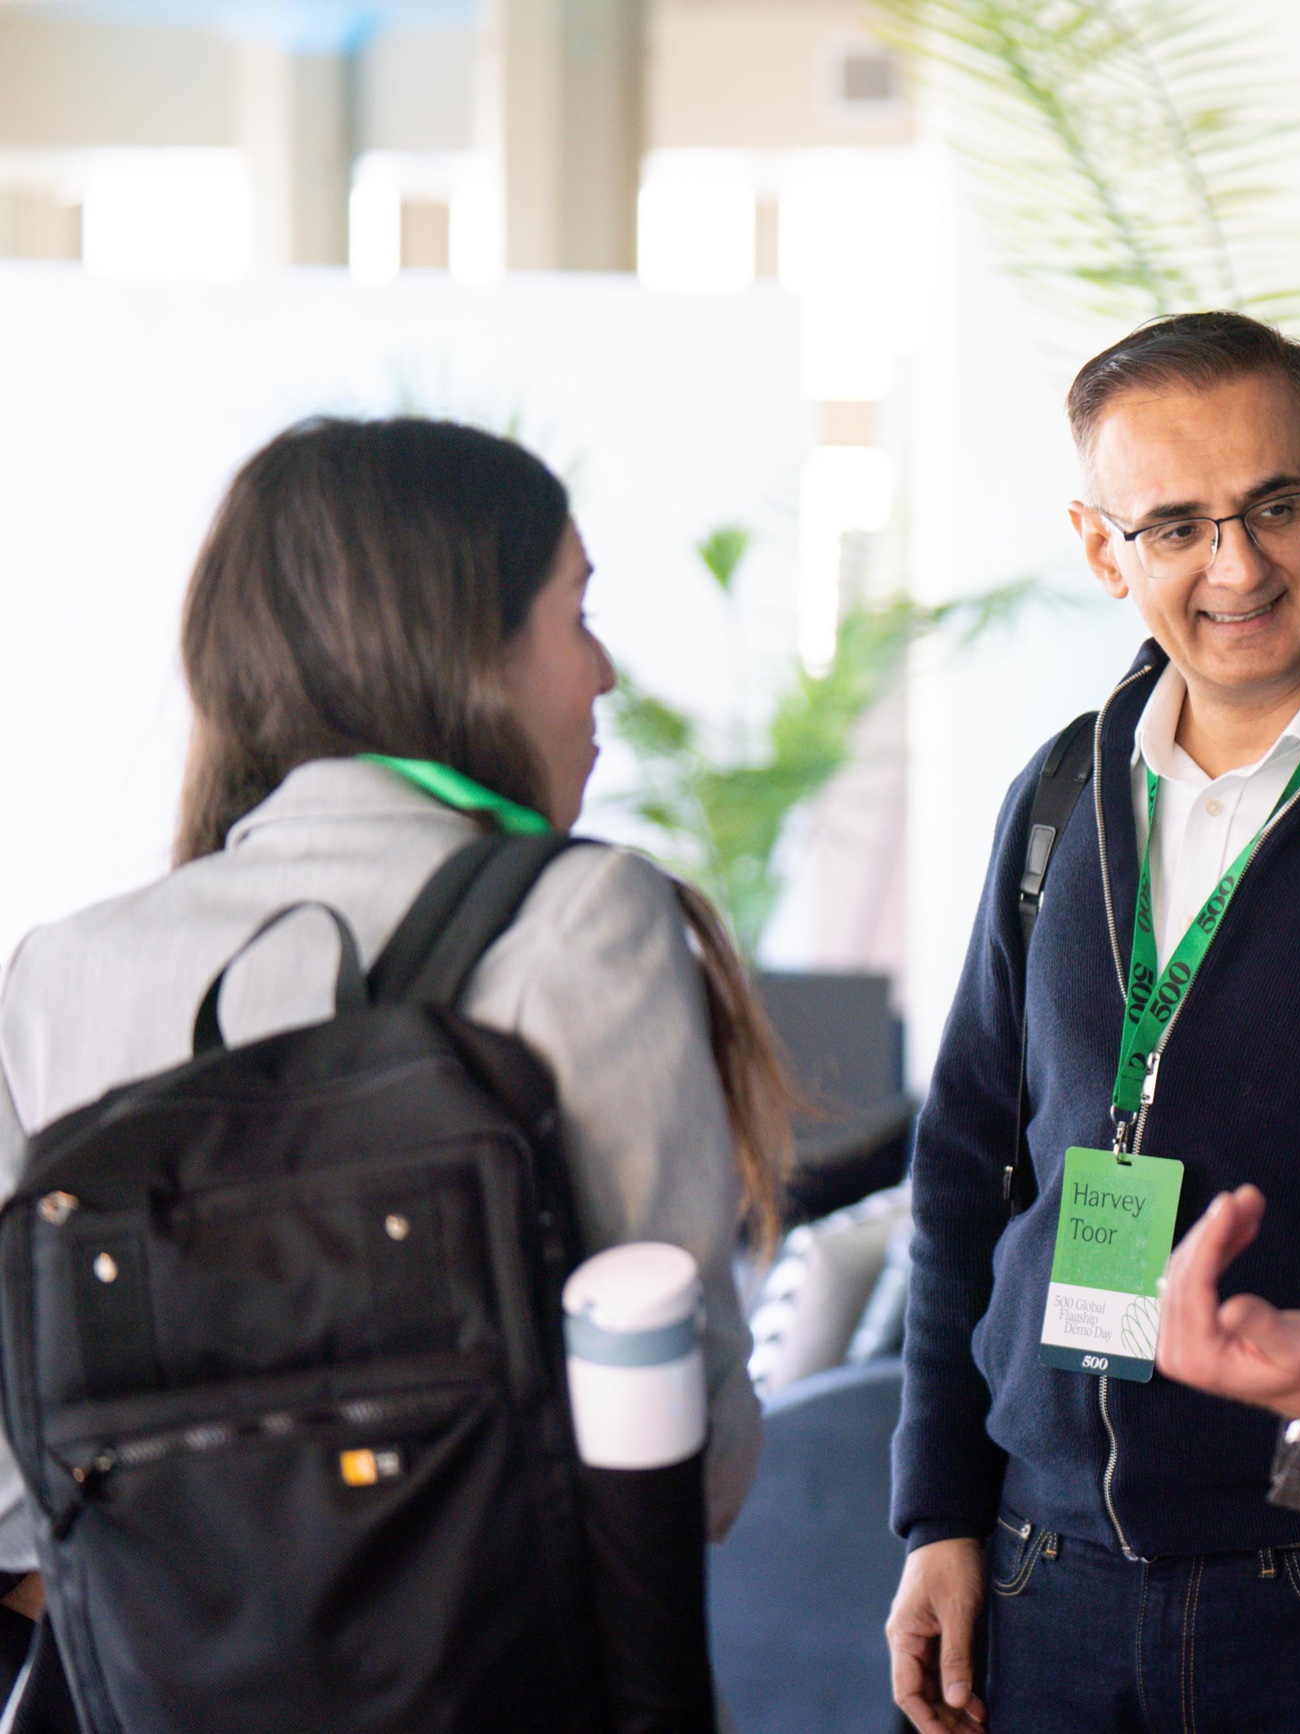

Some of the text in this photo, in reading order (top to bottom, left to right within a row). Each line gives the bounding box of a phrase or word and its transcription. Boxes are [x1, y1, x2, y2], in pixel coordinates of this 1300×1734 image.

[1197, 875, 1234, 934] 500
[1149, 961, 1191, 1023] 500
[1074, 1182, 1146, 1217] Harvey
[1071, 1218, 1117, 1244] Toor
[1054, 1296, 1106, 1314] 500 Global
[1059, 1311, 1098, 1326] Flagship
[1064, 1322, 1113, 1342] Demo Day
[1082, 1355, 1108, 1370] 500
